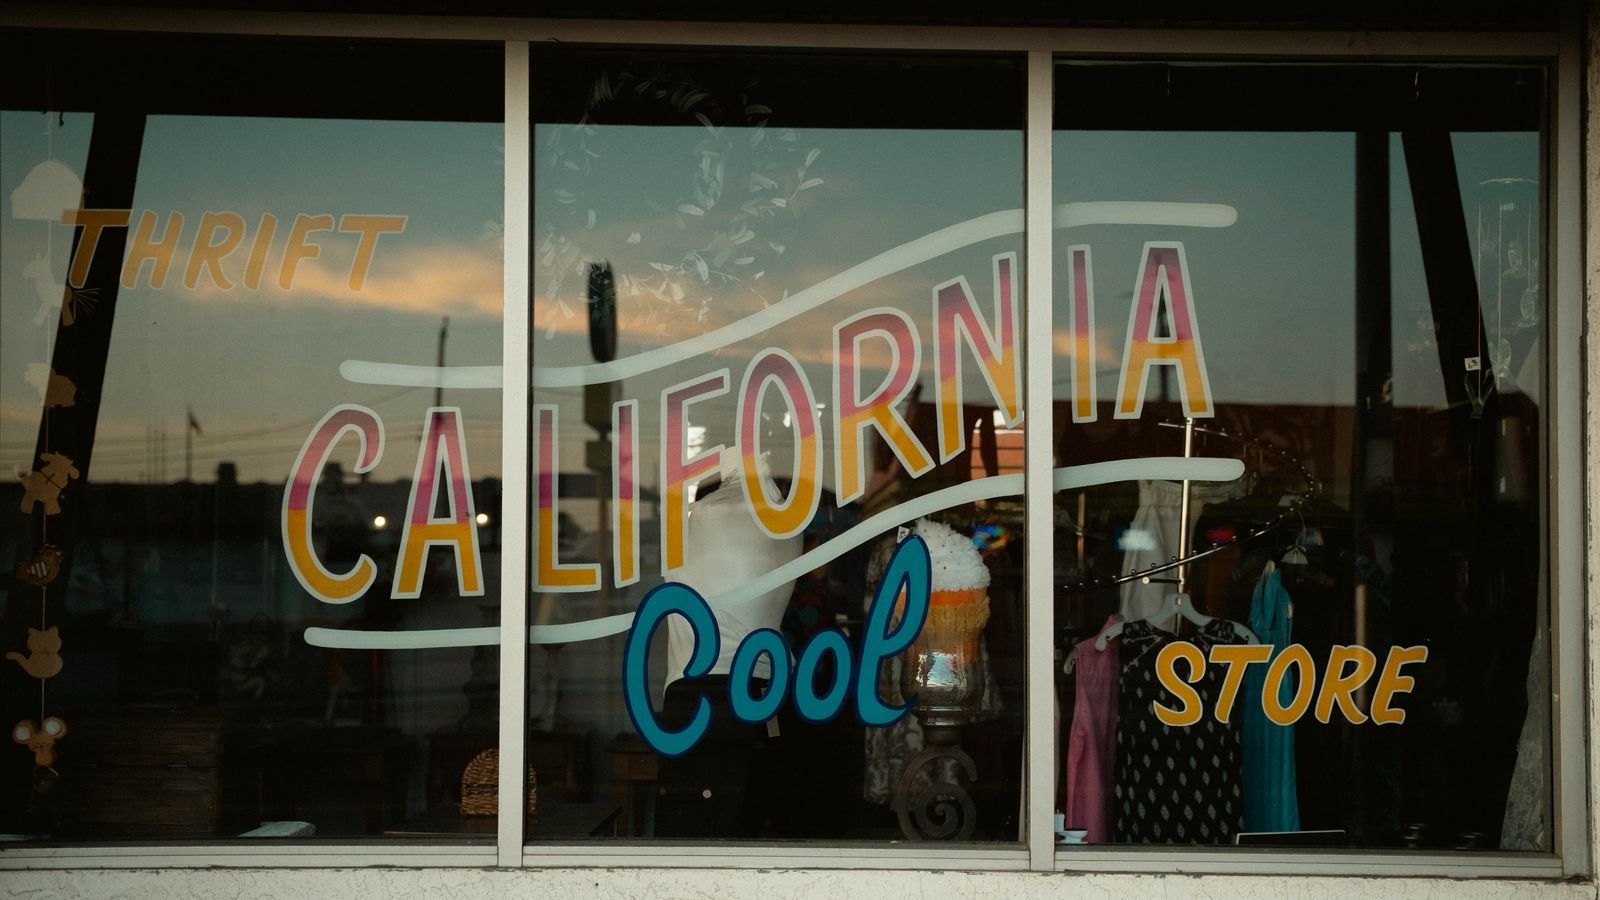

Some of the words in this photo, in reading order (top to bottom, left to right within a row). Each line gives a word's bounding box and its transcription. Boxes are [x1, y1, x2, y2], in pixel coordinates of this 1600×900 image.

[61, 208, 409, 291] THRIFT
[281, 240, 1216, 605] CALIFORNIA
[622, 534, 933, 757] Cool
[1152, 640, 1430, 727] STORE
